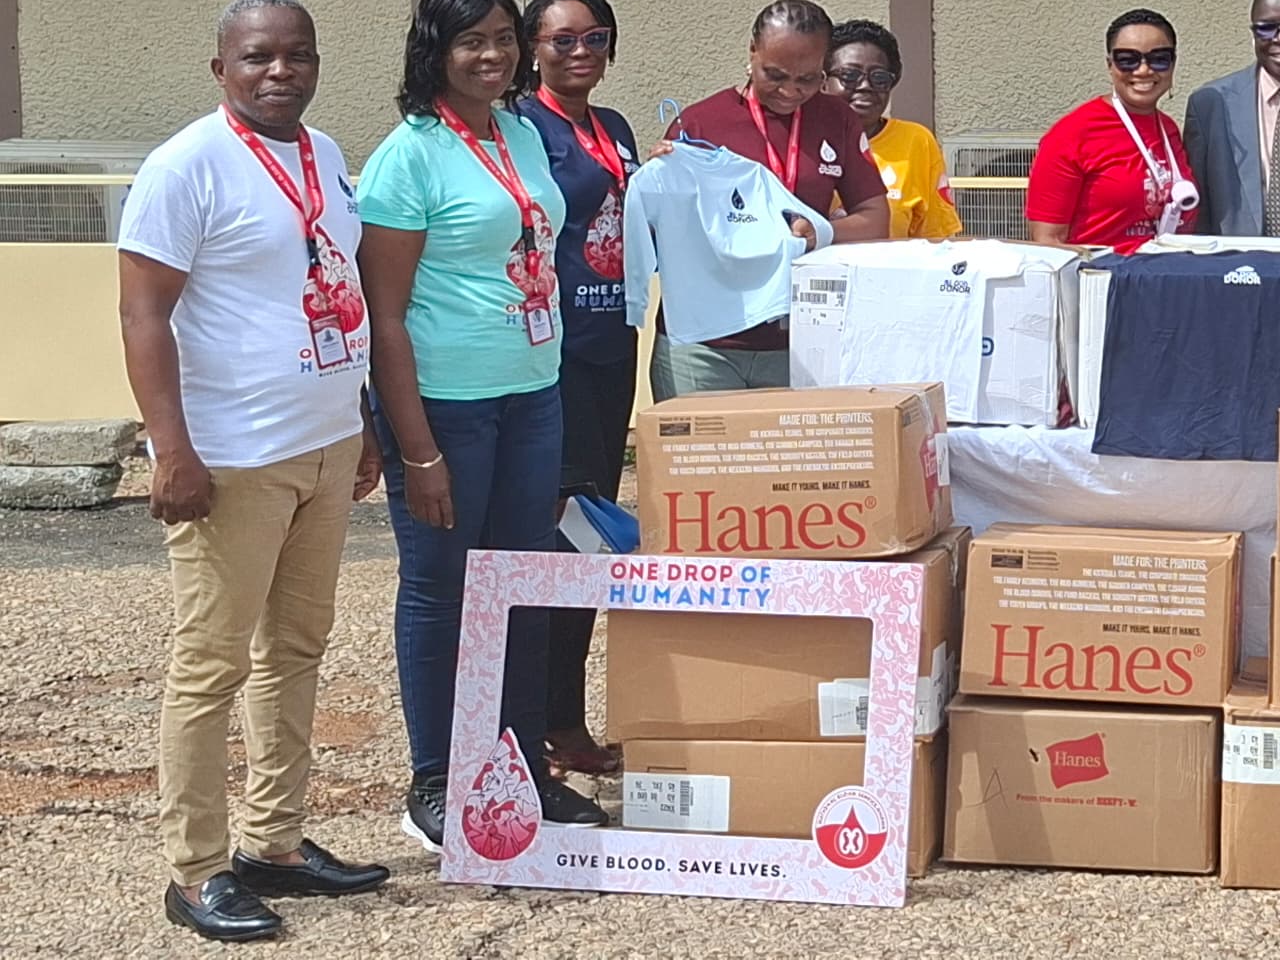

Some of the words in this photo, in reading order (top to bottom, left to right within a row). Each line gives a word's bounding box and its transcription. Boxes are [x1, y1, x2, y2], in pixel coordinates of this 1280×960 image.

[576, 284, 608, 296] ONE
[819, 413, 834, 424] THE
[772, 482, 789, 492] MAKE
[792, 482, 798, 491] IT
[822, 481, 840, 490] MAKE
[842, 480, 848, 489] IT
[1154, 556, 1169, 569] THE
[610, 562, 658, 580] ONE
[667, 564, 733, 582] DROP
[741, 566, 771, 583] OF
[609, 585, 770, 607] HUMANITY
[1102, 623, 1120, 633] MAKE
[1122, 624, 1128, 633] IT
[1153, 625, 1171, 635] MAKE
[1172, 626, 1178, 635] IT
[1054, 751, 1101, 768] Hanes
[1016, 793, 1038, 802] From
[1039, 795, 1052, 803] the
[1054, 796, 1084, 805] makers
[1086, 797, 1095, 805] of
[556, 854, 599, 868] GIVE
[606, 856, 671, 872] BLOOD.
[678, 860, 723, 874] SAVE
[729, 862, 787, 879] LIVES.
